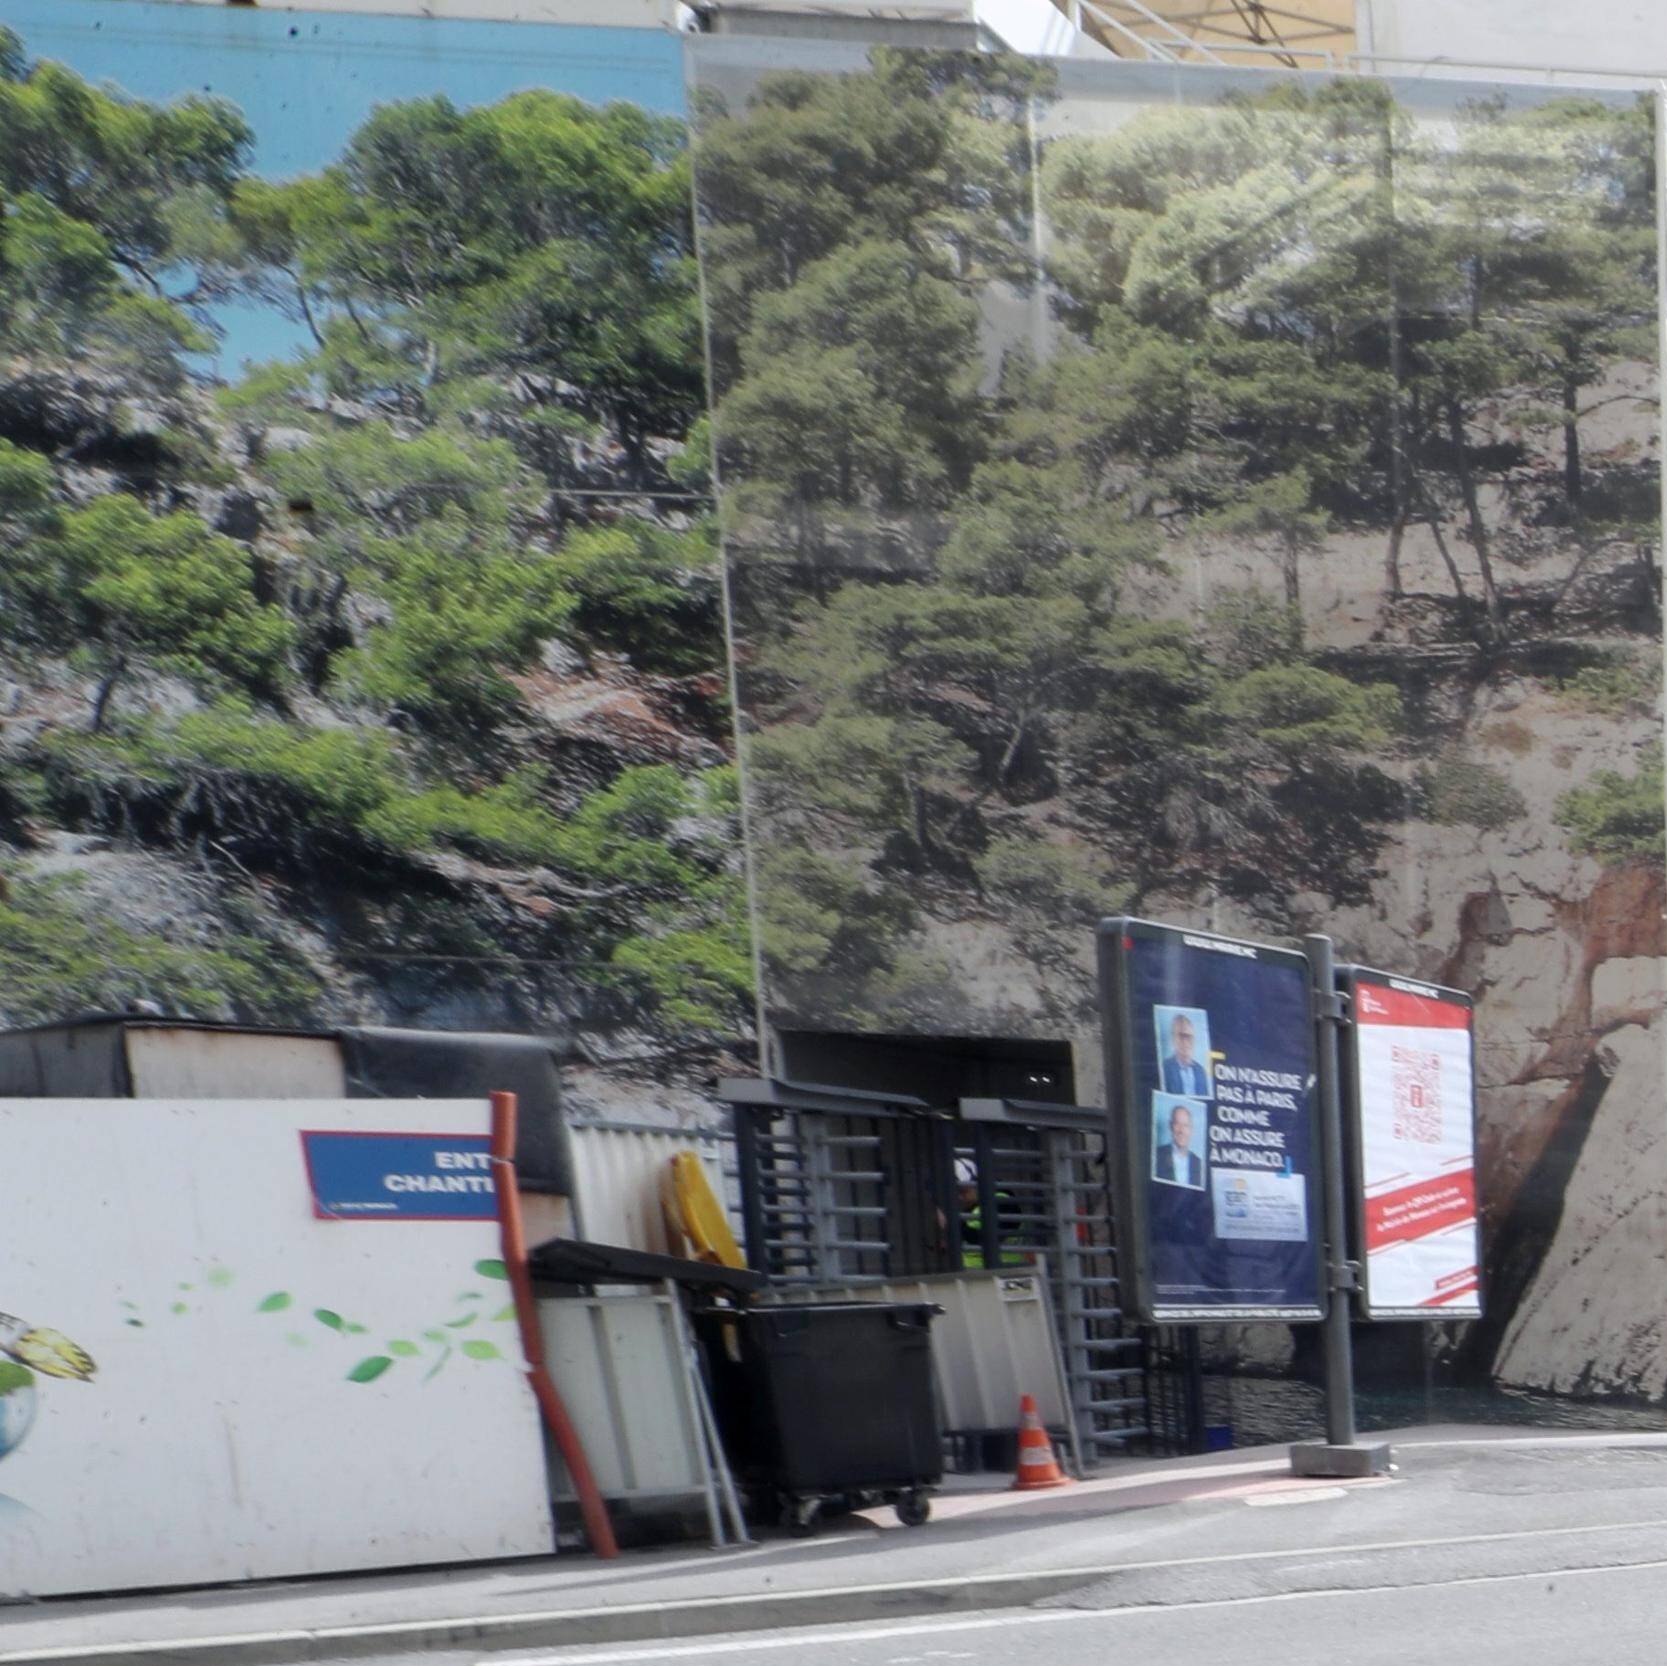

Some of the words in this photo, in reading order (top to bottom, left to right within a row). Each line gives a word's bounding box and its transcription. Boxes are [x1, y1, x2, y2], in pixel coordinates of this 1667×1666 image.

[1215, 1063, 1237, 1081] ON
[1216, 1084, 1244, 1103] PAS
[1217, 1106, 1271, 1127] COMME
[1209, 1125, 1233, 1142] ON
[1232, 1128, 1286, 1149] ASSURE
